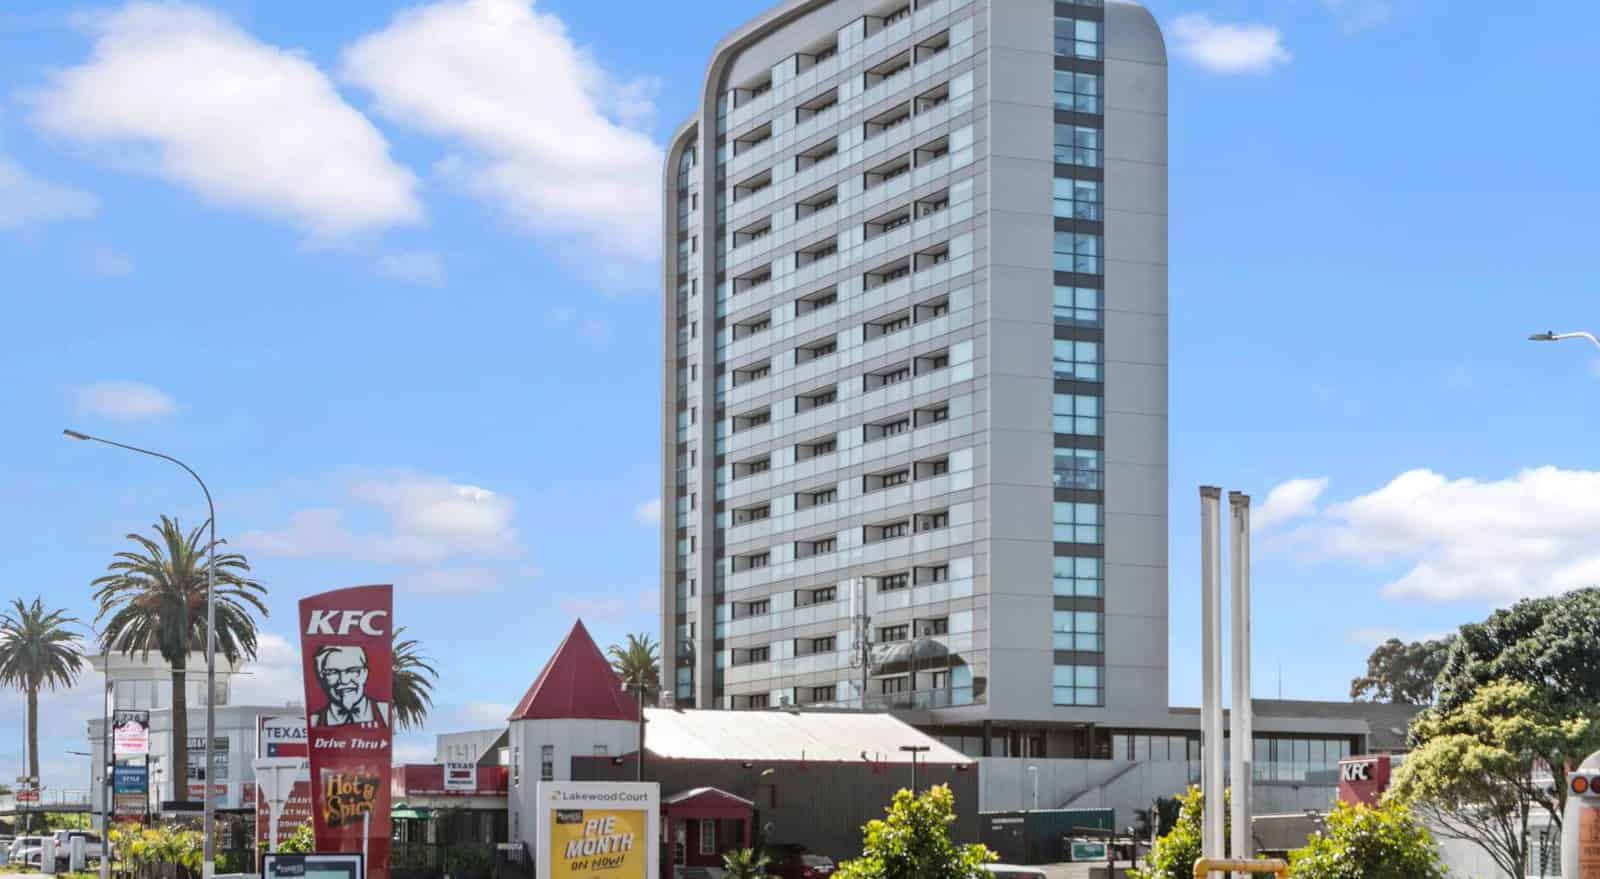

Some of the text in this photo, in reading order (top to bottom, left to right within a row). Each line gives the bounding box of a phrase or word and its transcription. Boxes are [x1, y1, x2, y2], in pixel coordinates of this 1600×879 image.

[306, 609, 388, 636] KFC
[265, 727, 308, 739] TEXAS
[314, 738, 378, 749] Drive Thru
[1344, 762, 1368, 781] KFC
[327, 774, 363, 796] Hot
[562, 792, 648, 801] Lakewood Court
[328, 796, 377, 825] Spicy
[583, 815, 616, 836] PIE
[564, 831, 634, 860] MONTH
[571, 855, 625, 872] ON NOW!
